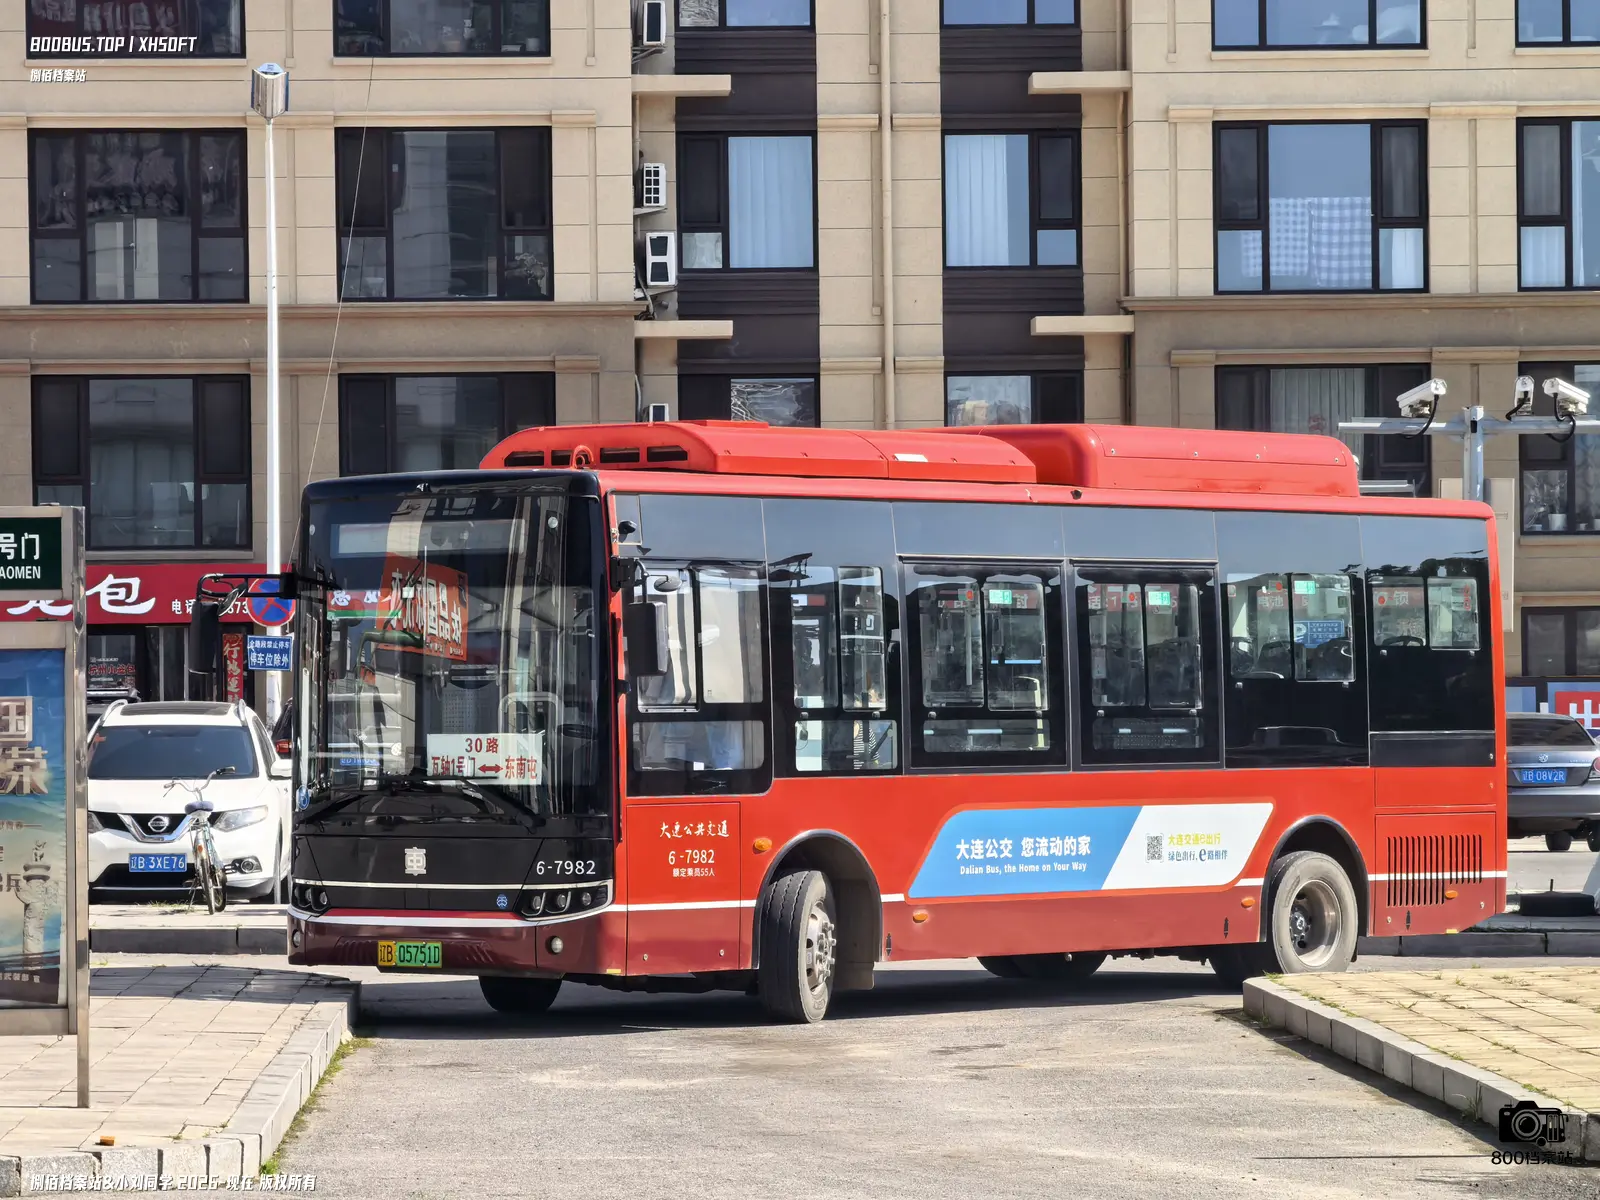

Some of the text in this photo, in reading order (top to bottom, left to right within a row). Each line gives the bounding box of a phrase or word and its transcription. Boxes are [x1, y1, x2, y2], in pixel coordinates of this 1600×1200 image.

[0, 531, 40, 560] 号门
[250, 652, 289, 667] 停车位除外
[465, 737, 499, 754] 30路
[0, 746, 48, 795] 荣
[504, 755, 538, 779] 东南屯
[659, 820, 730, 839] 大连公共交通
[956, 835, 1091, 860] 大连公交 您流动的家
[668, 849, 715, 865] 6-7982
[536, 859, 597, 876] 6-7982
[960, 861, 1087, 875] Dalian Bus, the Home on Your Way
